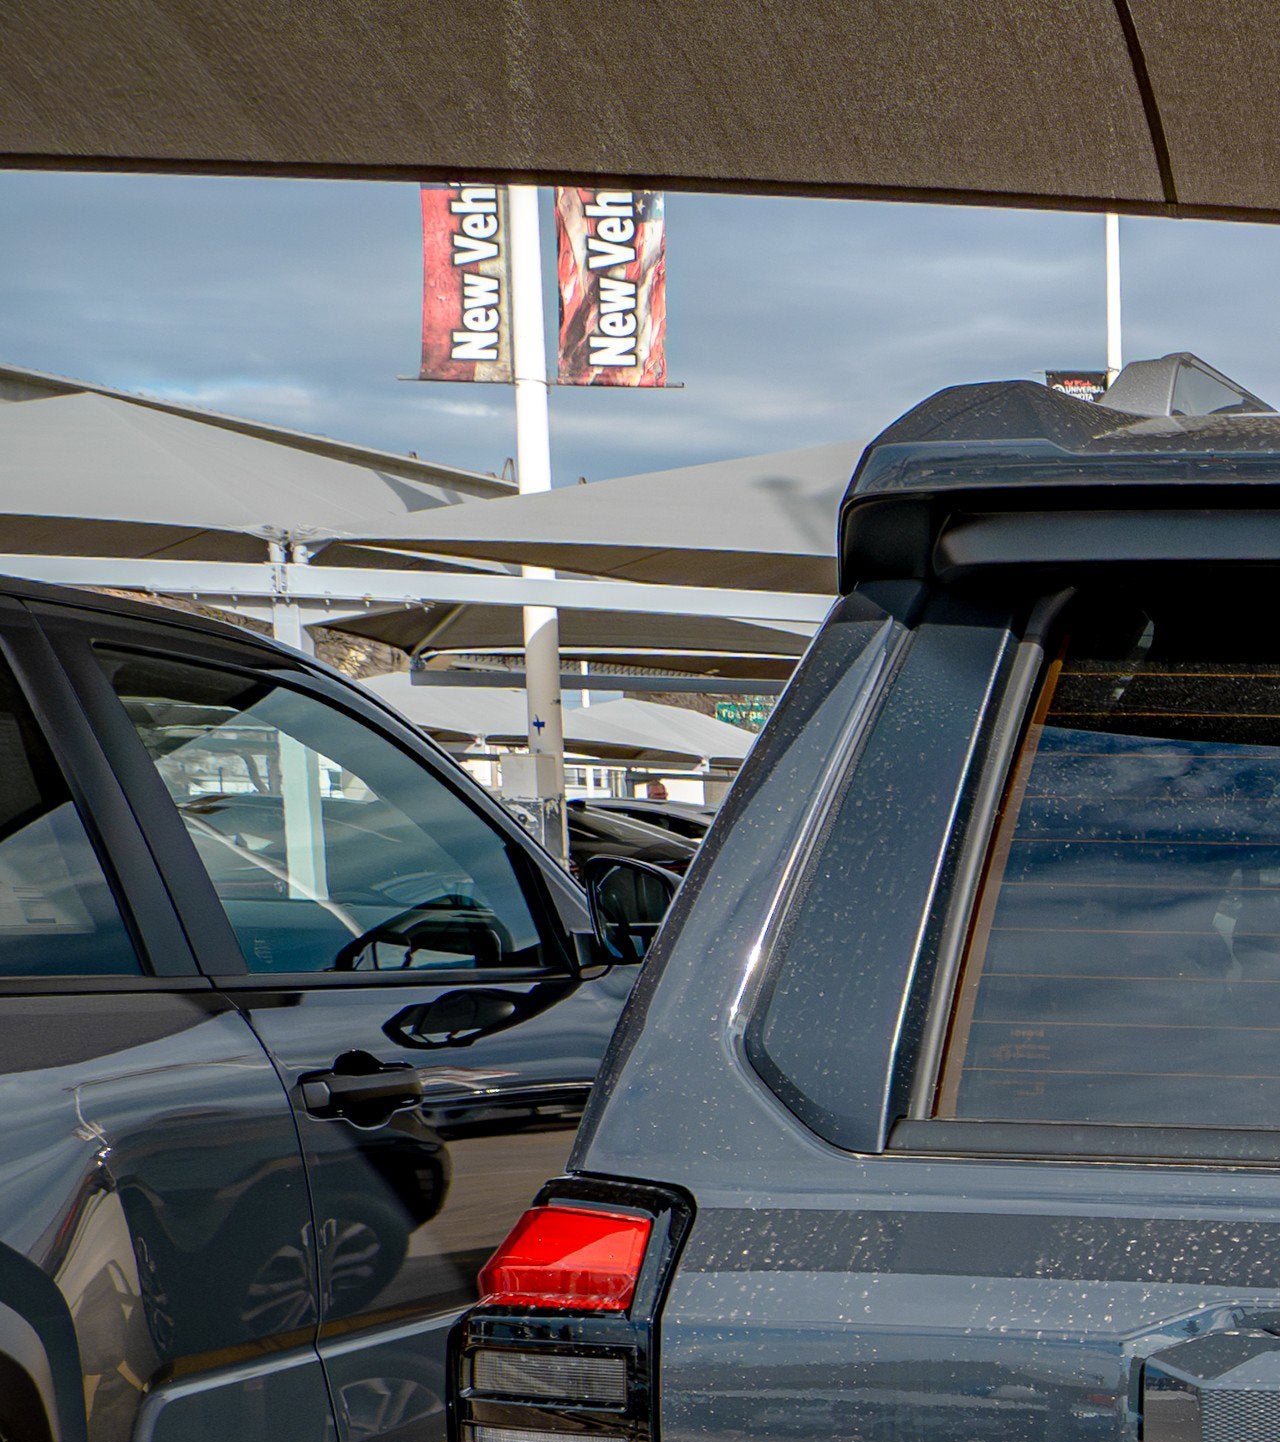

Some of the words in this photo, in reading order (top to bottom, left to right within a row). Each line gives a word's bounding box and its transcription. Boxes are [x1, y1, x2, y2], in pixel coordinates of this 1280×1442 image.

[450, 182, 498, 265] Veh
[451, 273, 499, 360] New
[589, 278, 637, 366] New
